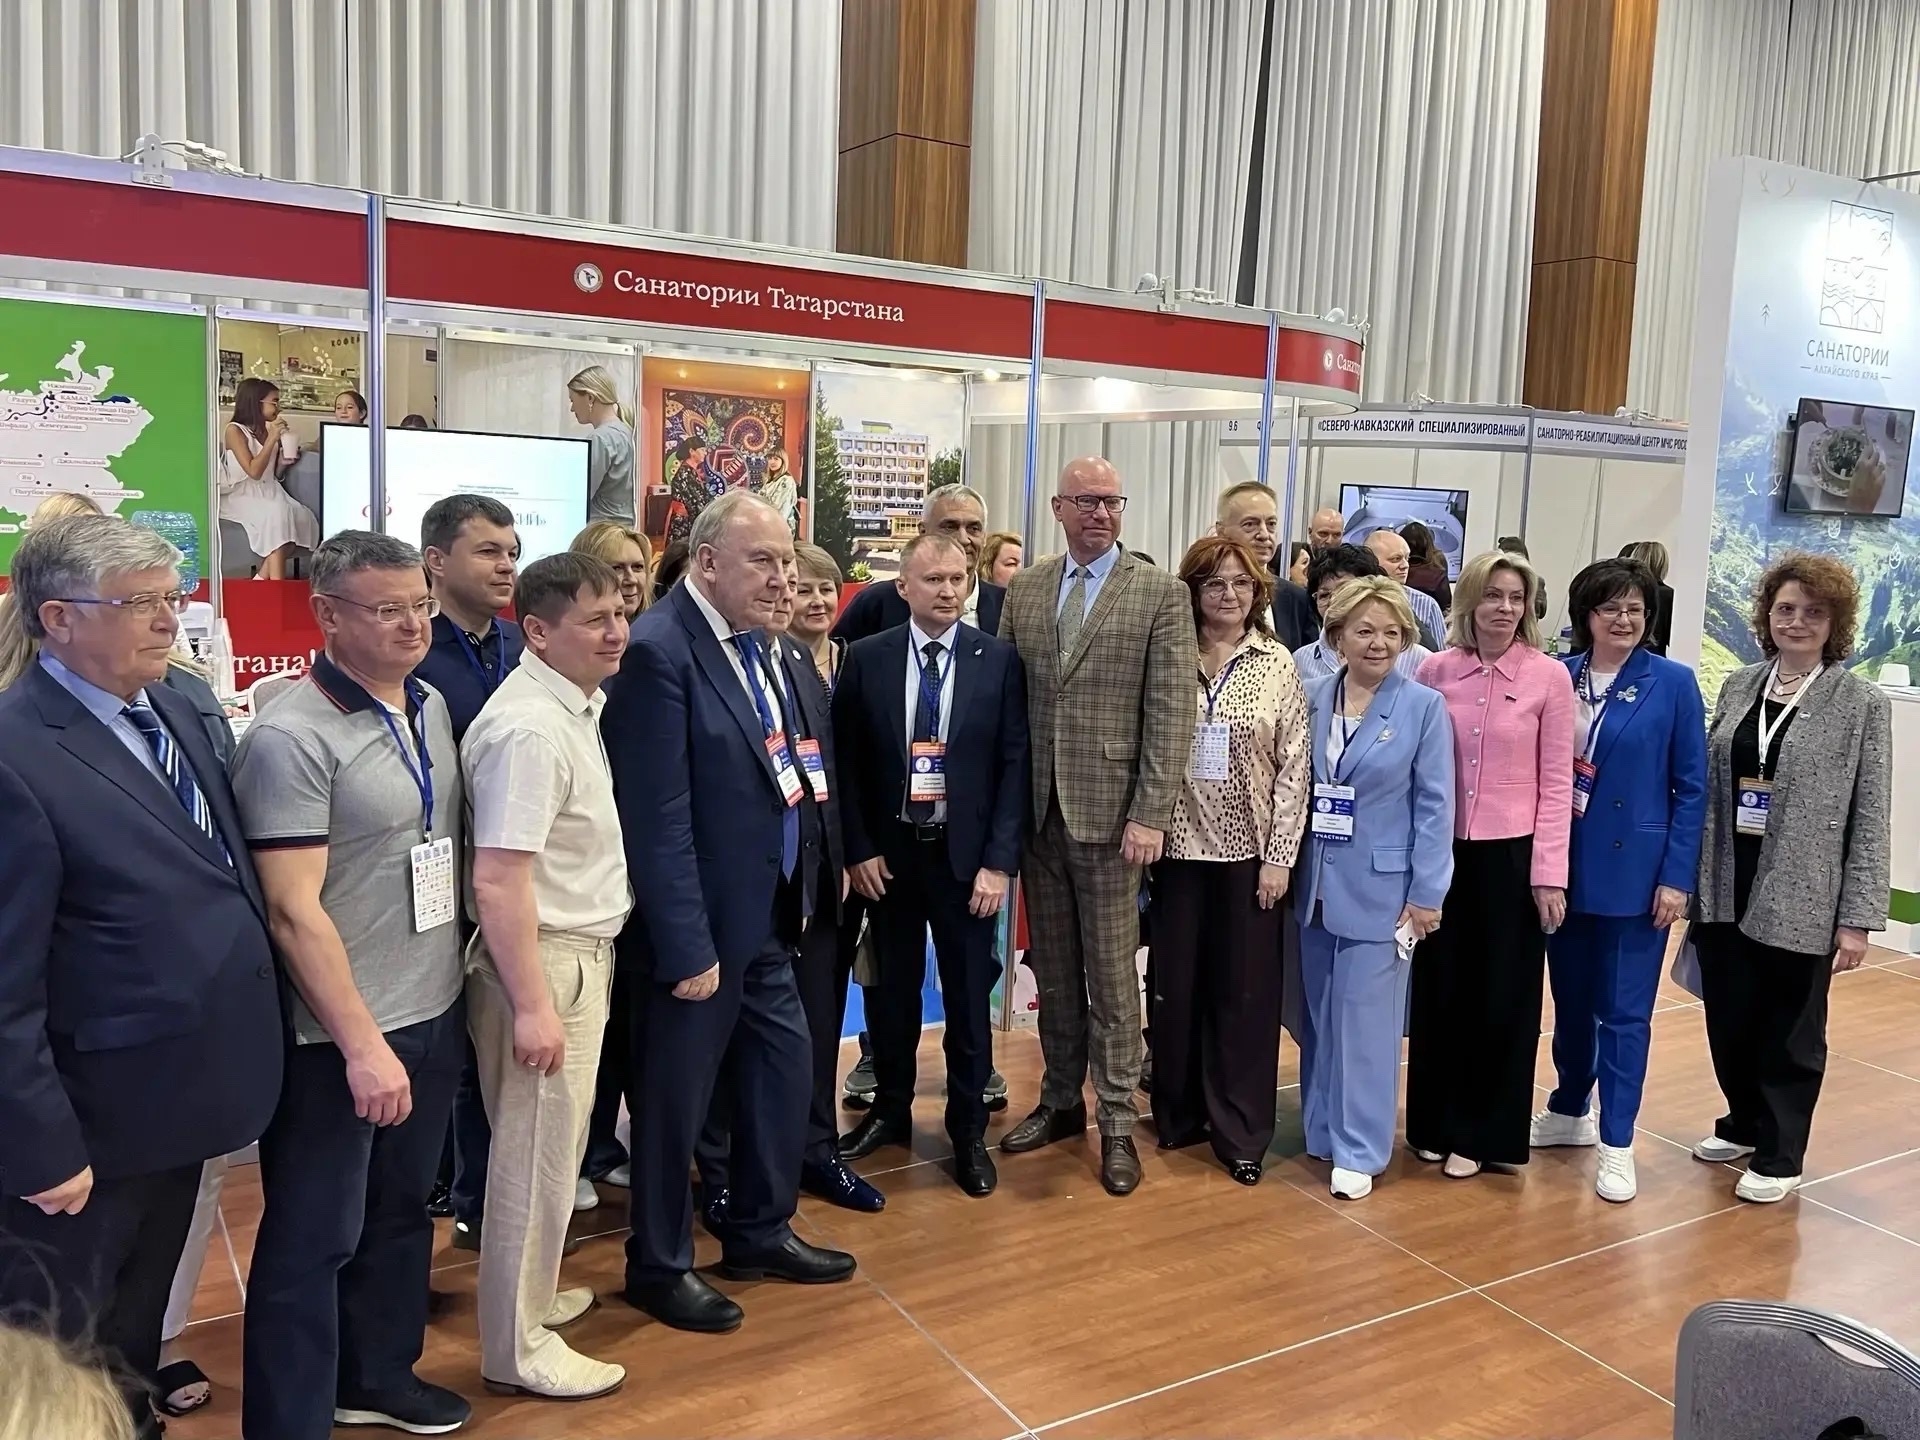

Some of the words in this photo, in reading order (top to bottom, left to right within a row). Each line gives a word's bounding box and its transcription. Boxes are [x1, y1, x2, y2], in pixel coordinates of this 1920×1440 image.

[614, 270, 760, 308] Санатории
[766, 286, 905, 323] Татарстана
[1807, 340, 1889, 366] САНАТОРИИ
[1862, 371, 1879, 380] КРАЯ
[1317, 418, 1414, 433] «СЕВЕРО-КАВКАЗСКИЙ
[1418, 420, 1526, 437] СПЕЦИАЛИЗИРОВАННЫЙ
[1537, 427, 1640, 446] САНАТОРНО-РЕАБИЛИТАЦИОННЫЙ
[1641, 435, 1661, 448] ЦЕНТР
[1661, 438, 1673, 448] МЧС
[1315, 833, 1348, 841] УЧАСТНИК
